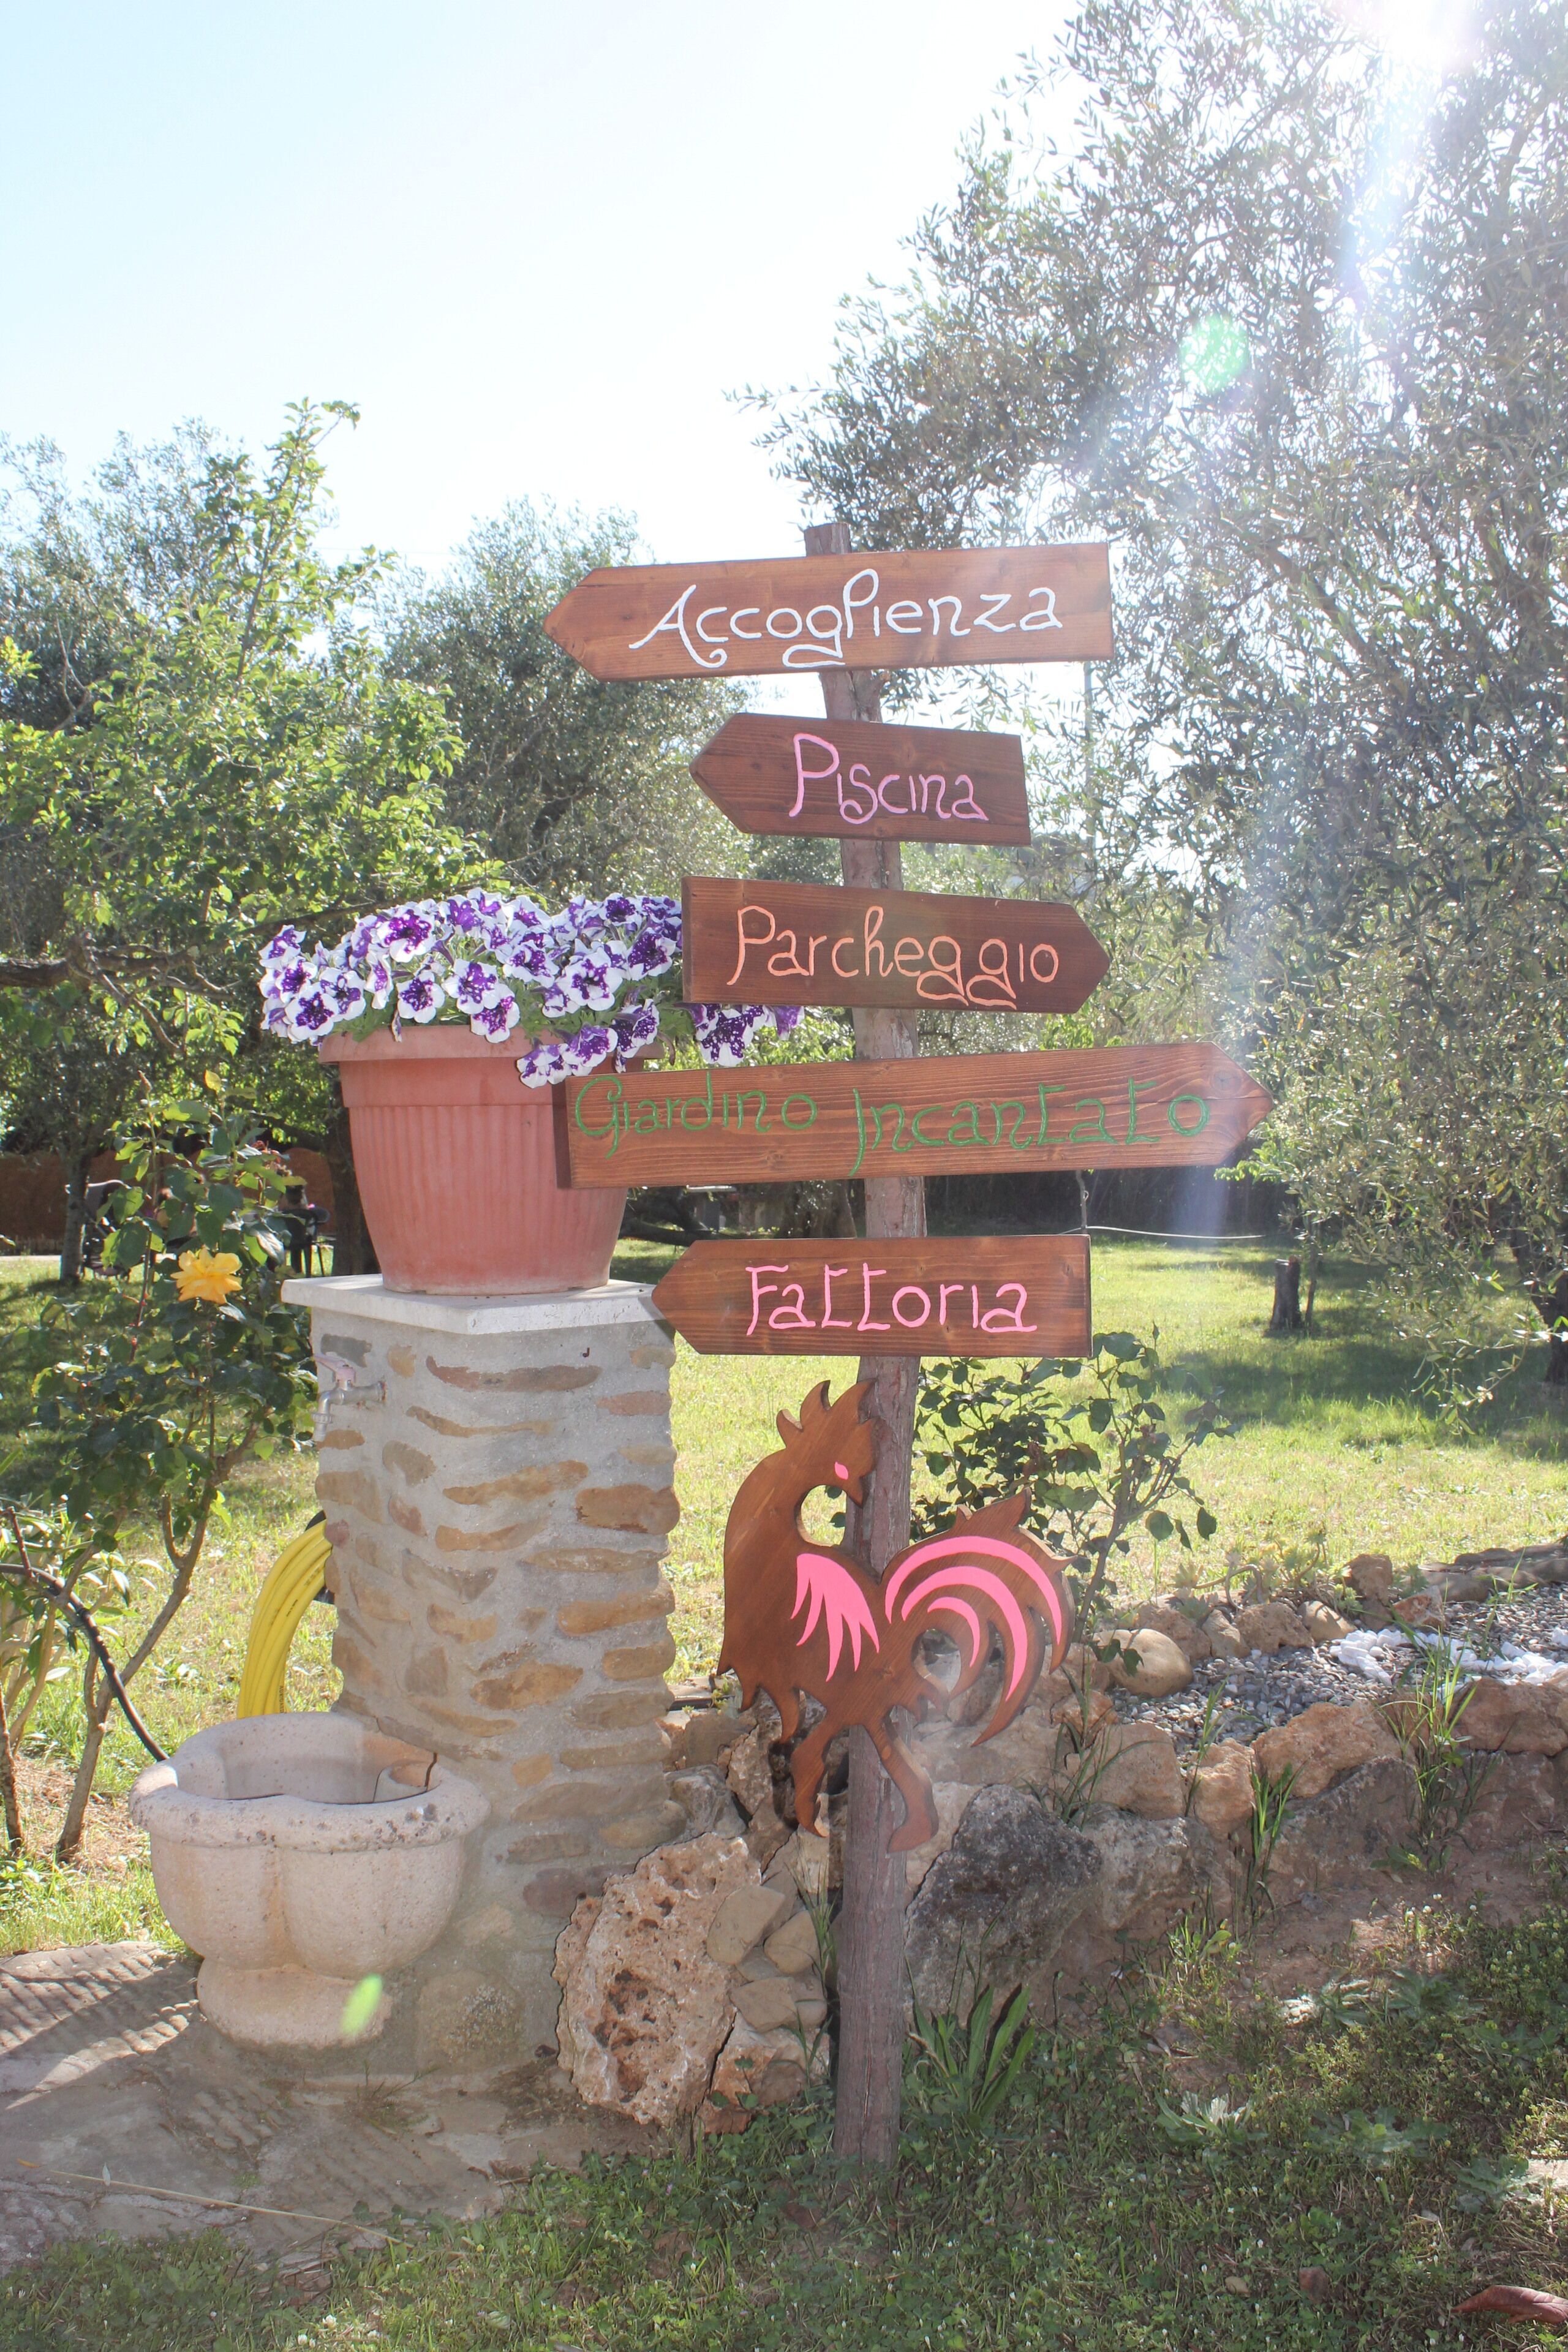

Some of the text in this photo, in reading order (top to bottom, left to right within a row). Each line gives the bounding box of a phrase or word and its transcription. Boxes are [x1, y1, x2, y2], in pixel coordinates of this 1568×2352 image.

[628, 568, 1062, 668] Accoglienza
[788, 733, 988, 824] Piscina
[726, 905, 1059, 1010] Parcheggio
[575, 1071, 1210, 1177] Giardino Incantato
[745, 1262, 1037, 1336] Fattoria
